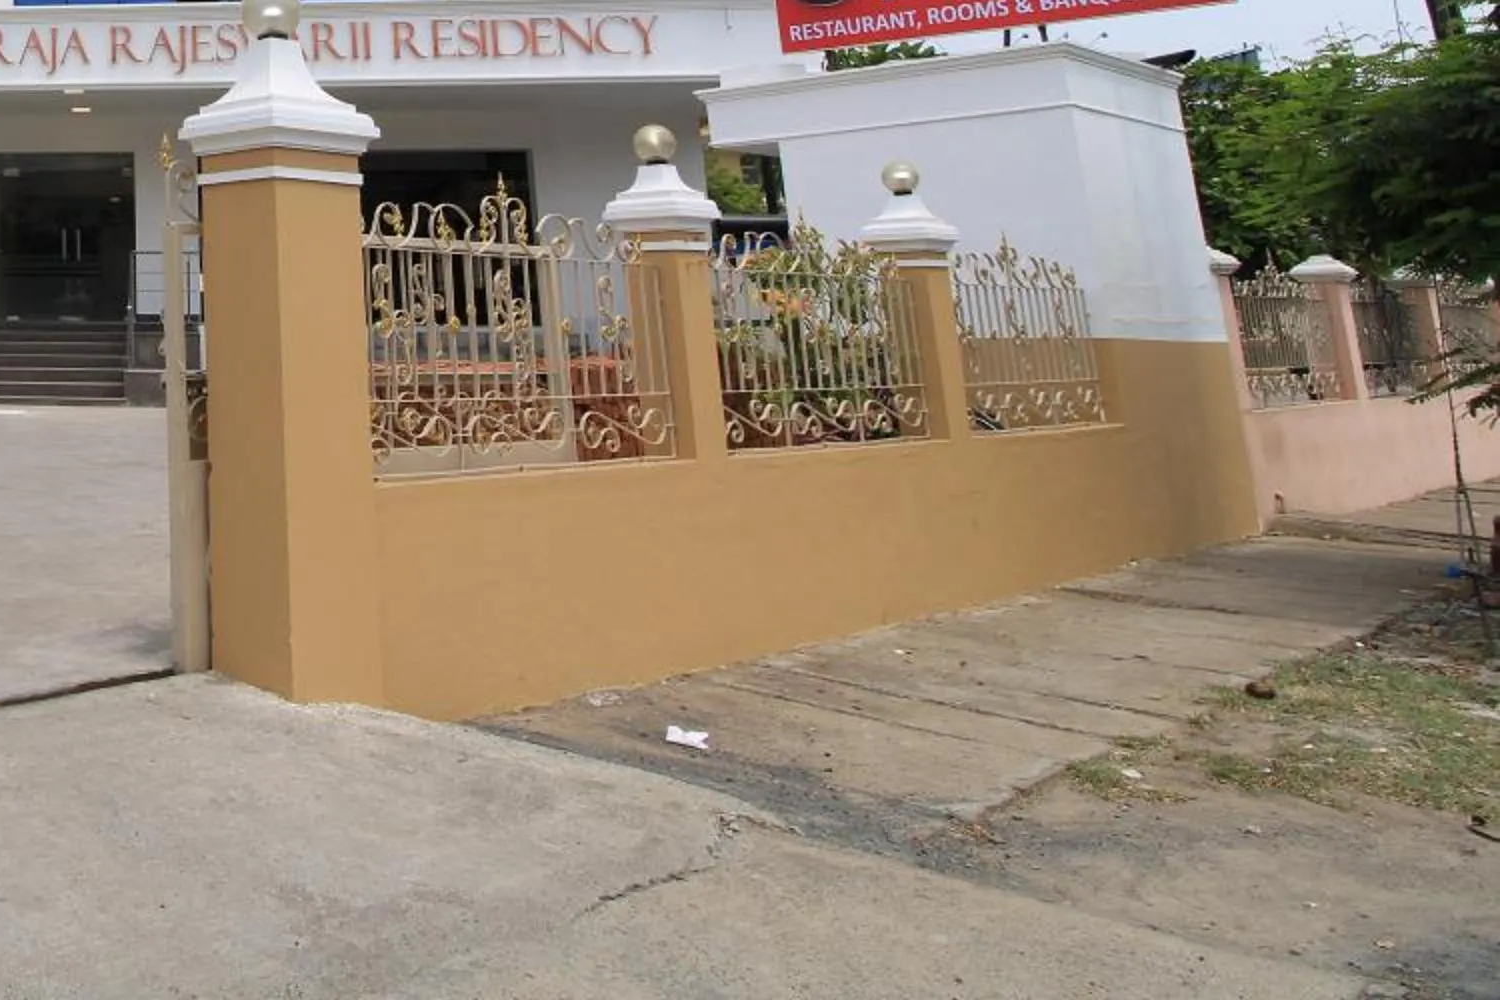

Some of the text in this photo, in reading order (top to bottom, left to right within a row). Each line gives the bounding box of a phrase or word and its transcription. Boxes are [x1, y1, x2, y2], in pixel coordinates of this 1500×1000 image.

[109, 21, 372, 75] RAJESRII
[391, 15, 659, 59] RESIDENCY
[790, 10, 922, 43] RESTAURANT,
[927, 0, 1009, 26] ROOMS
